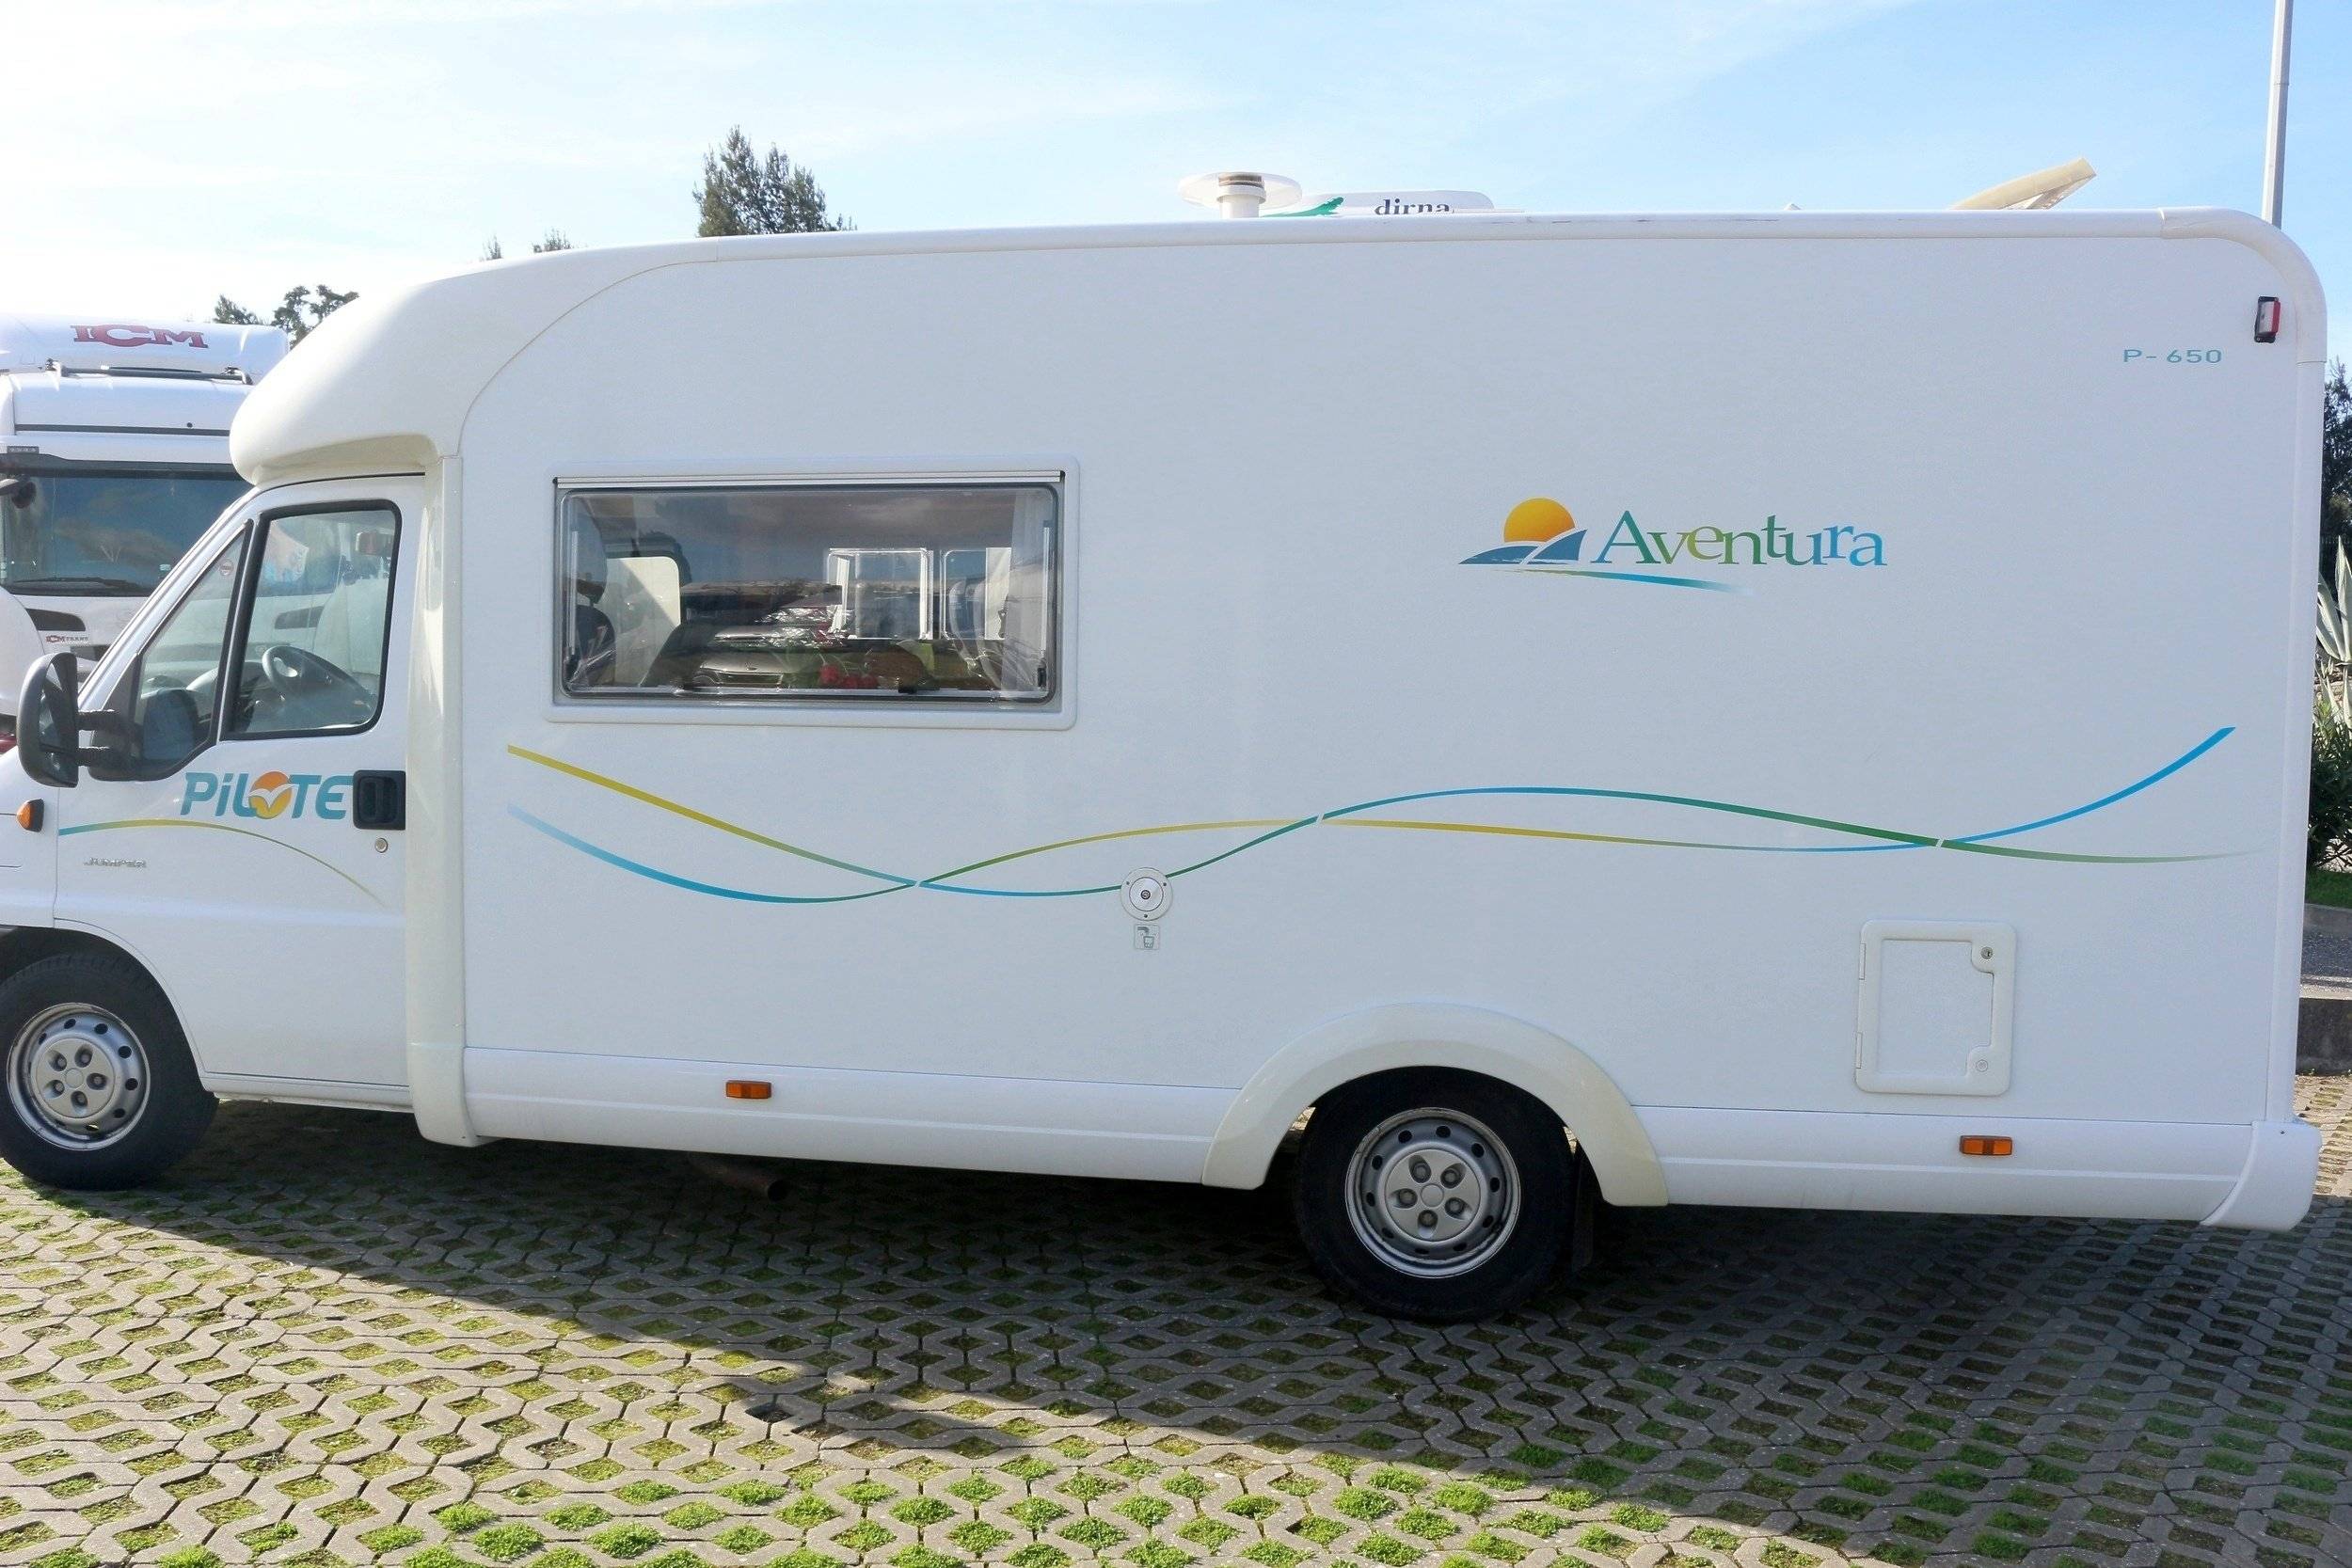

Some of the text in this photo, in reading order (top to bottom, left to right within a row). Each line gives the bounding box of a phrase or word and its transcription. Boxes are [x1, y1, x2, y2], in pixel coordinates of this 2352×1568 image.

[1374, 198, 1455, 215] dirna
[71, 324, 209, 348] ICM
[1590, 510, 1888, 566] Aventura
